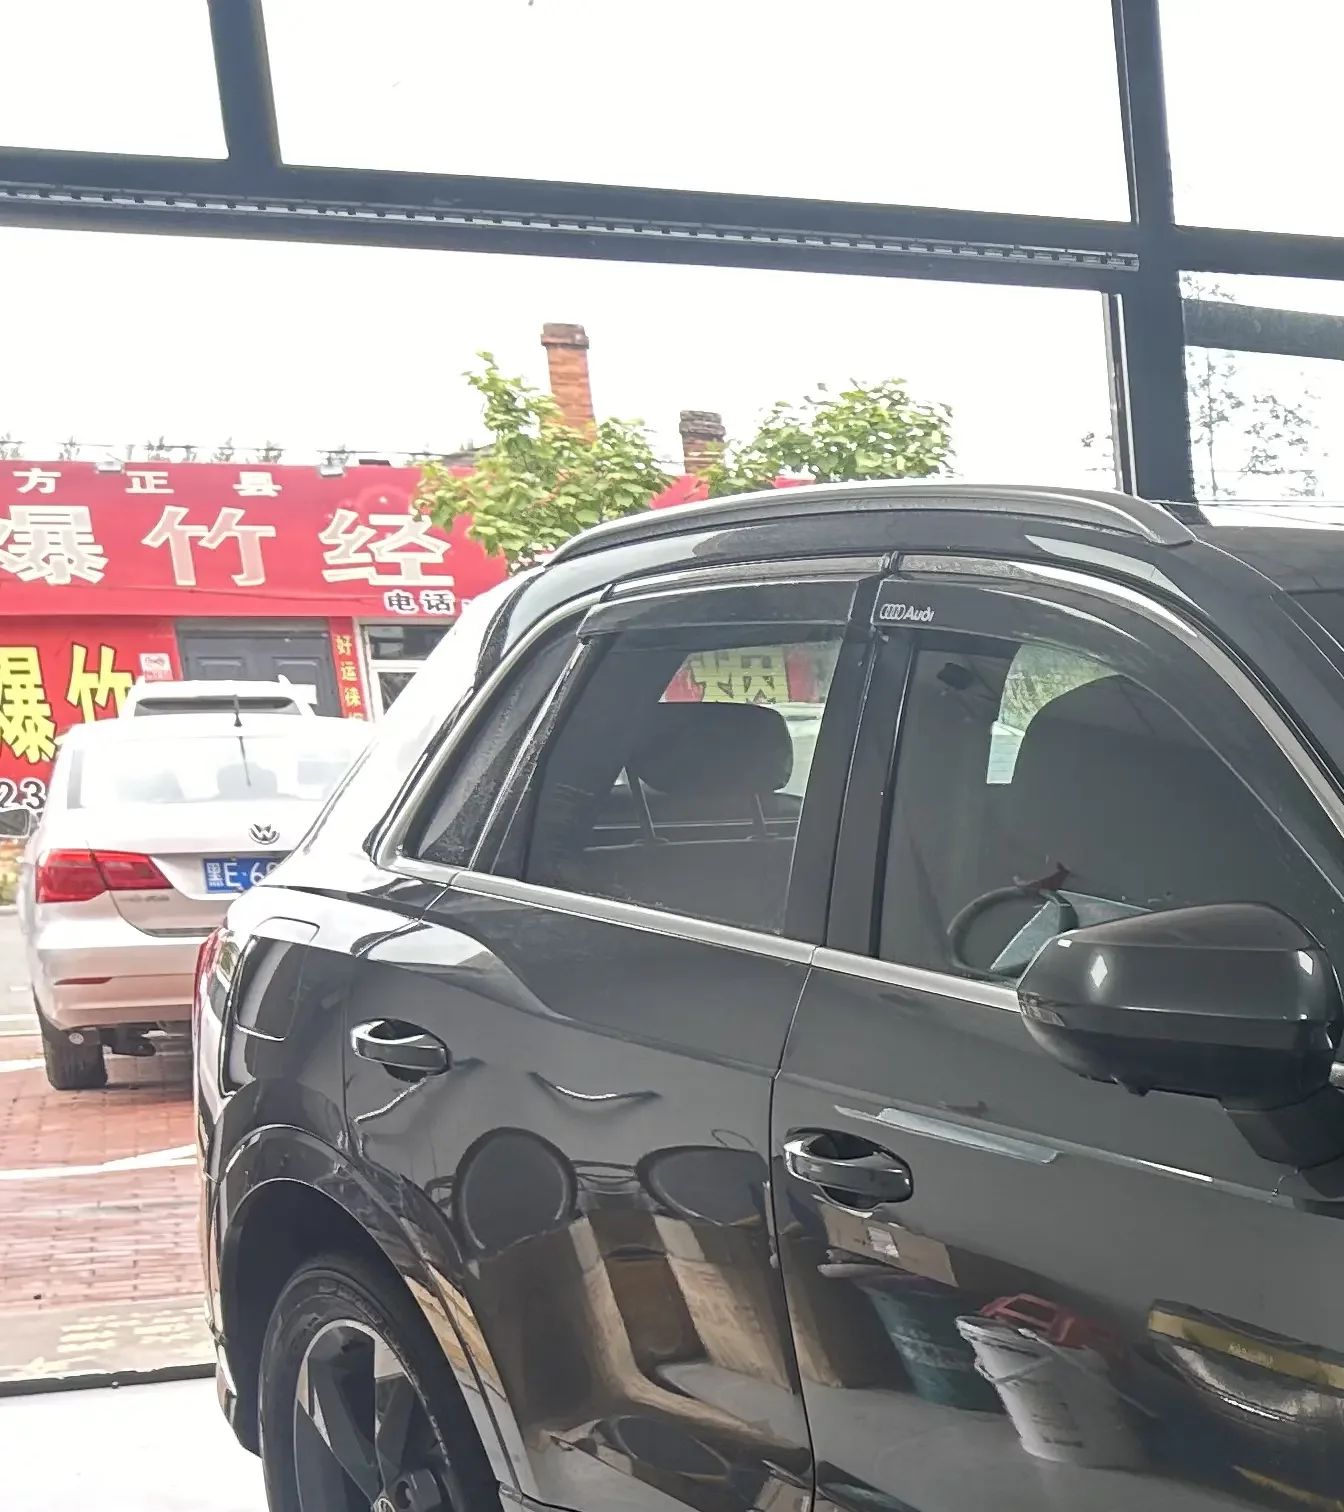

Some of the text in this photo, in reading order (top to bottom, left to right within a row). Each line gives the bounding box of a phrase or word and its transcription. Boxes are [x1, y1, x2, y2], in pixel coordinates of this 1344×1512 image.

[11, 467, 284, 497] 方正县
[386, 590, 456, 615] 电话
[904, 606, 936, 622] Audi
